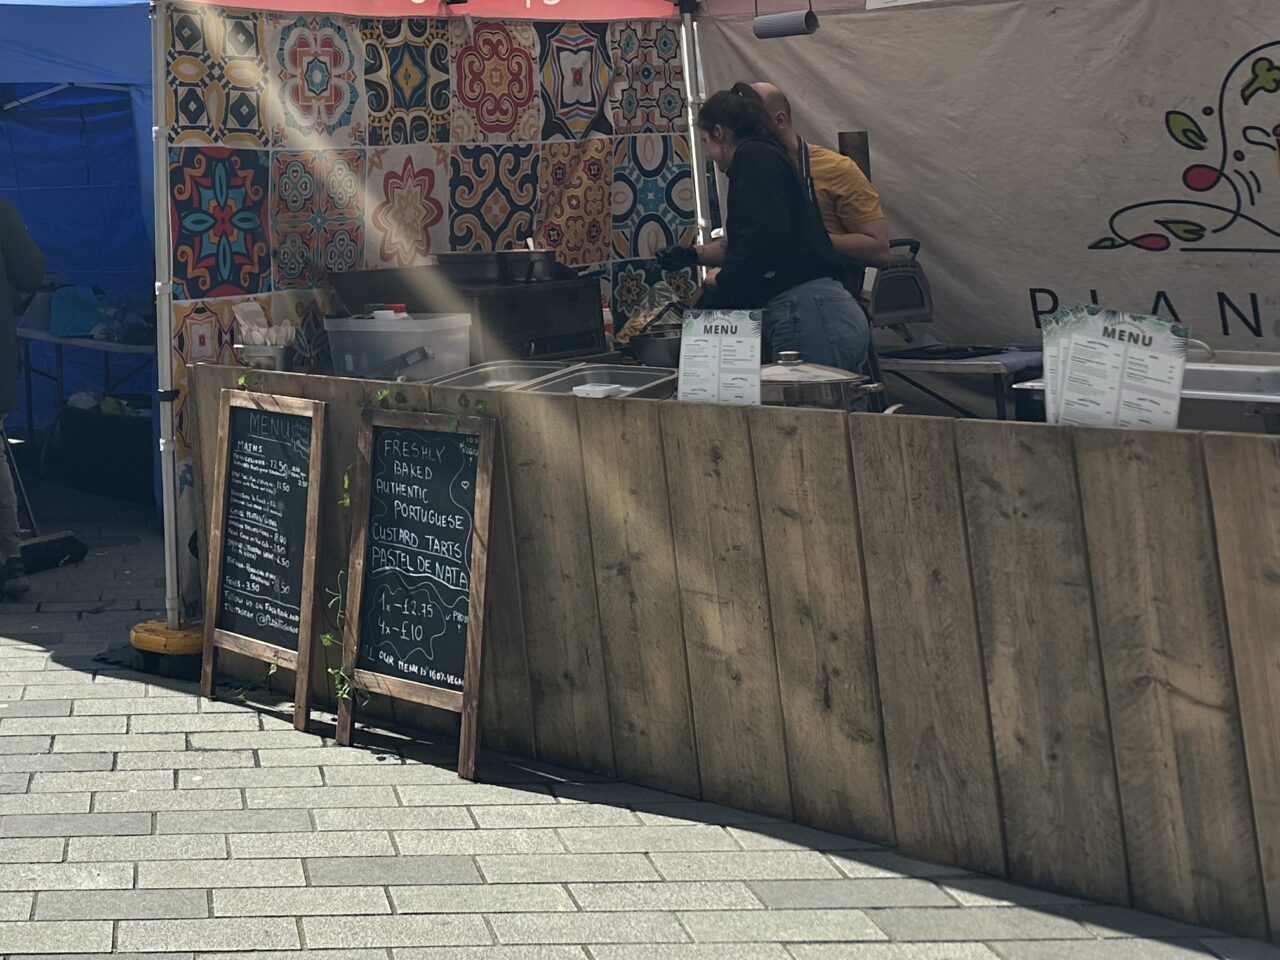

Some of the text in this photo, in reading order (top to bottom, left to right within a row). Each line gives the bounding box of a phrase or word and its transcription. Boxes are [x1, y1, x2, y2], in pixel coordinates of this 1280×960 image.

[703, 324, 738, 335] MENU
[1101, 326, 1153, 347] MENU
[249, 413, 291, 439] MENU
[237, 440, 263, 454] MAINS
[384, 439, 446, 463] FRESHLY
[393, 460, 433, 480] BAKED
[376, 478, 429, 504] AUTHENTIC
[394, 499, 464, 530] PORTUGUESE
[372, 522, 462, 558] CUSTARD TARTS
[372, 546, 469, 590] PASTEL DE NATA
[378, 651, 394, 667] OUR
